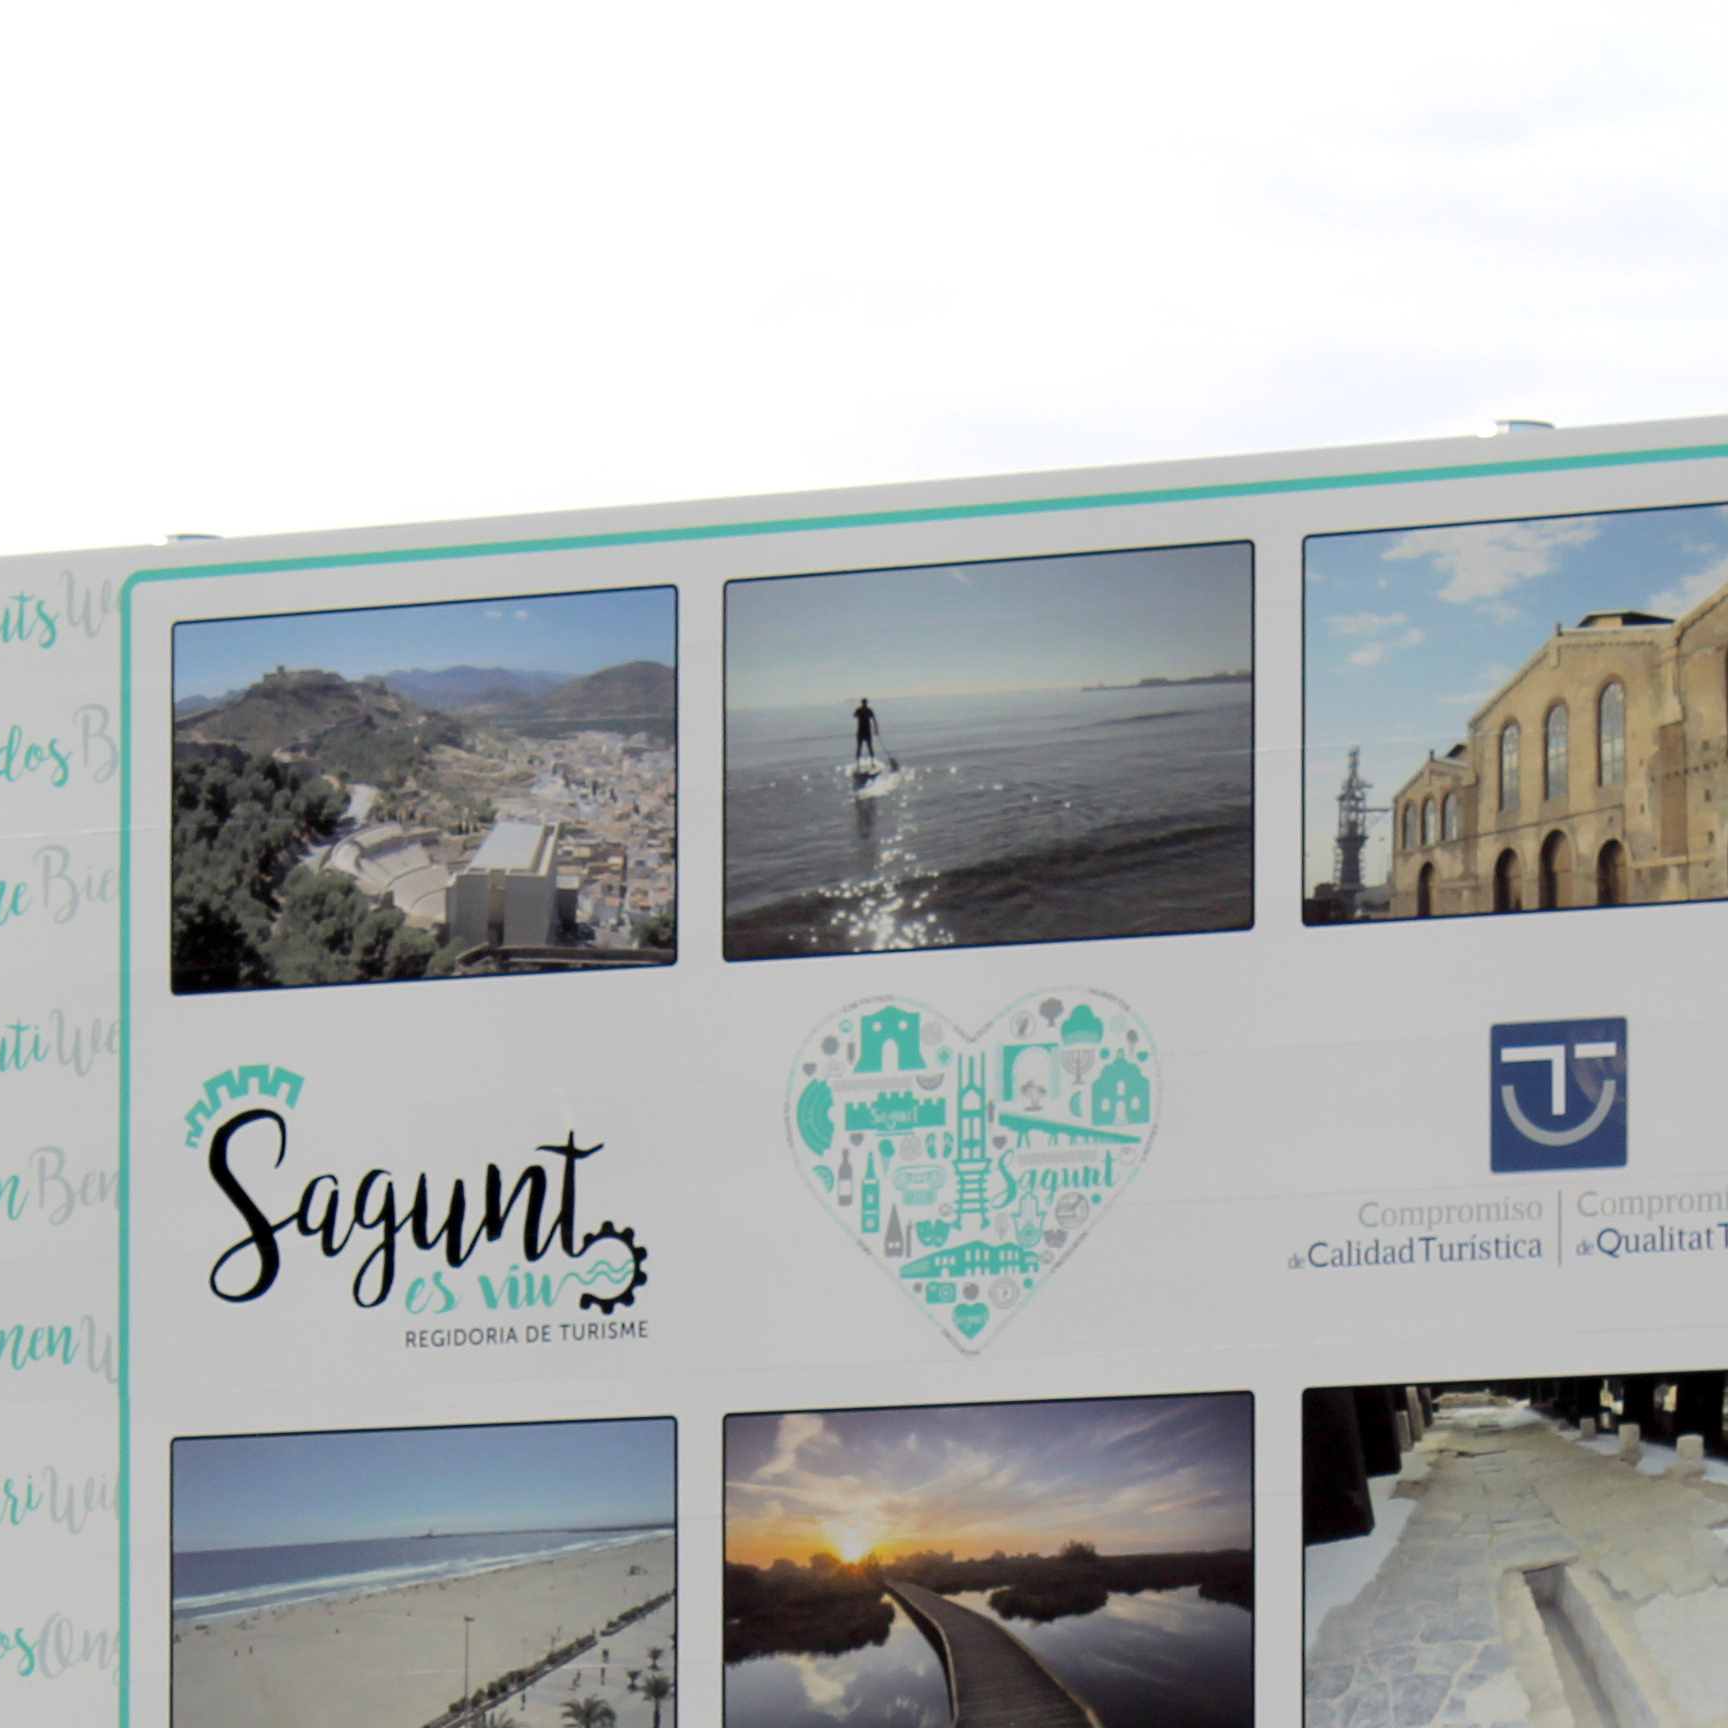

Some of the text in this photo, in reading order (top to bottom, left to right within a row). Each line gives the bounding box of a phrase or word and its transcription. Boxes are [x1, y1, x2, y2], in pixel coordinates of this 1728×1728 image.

[992, 1148, 1118, 1211] Sagunt
[209, 1108, 605, 1309] Sagunt
[1358, 1196, 1544, 1231] Compromiso
[1308, 1236, 1416, 1268] Calidad
[1418, 1233, 1544, 1264] Turística
[1596, 1224, 1716, 1259] Qualitat
[404, 1263, 560, 1314] es viu
[405, 1320, 650, 1349] REGIDORIA DE TURISME
